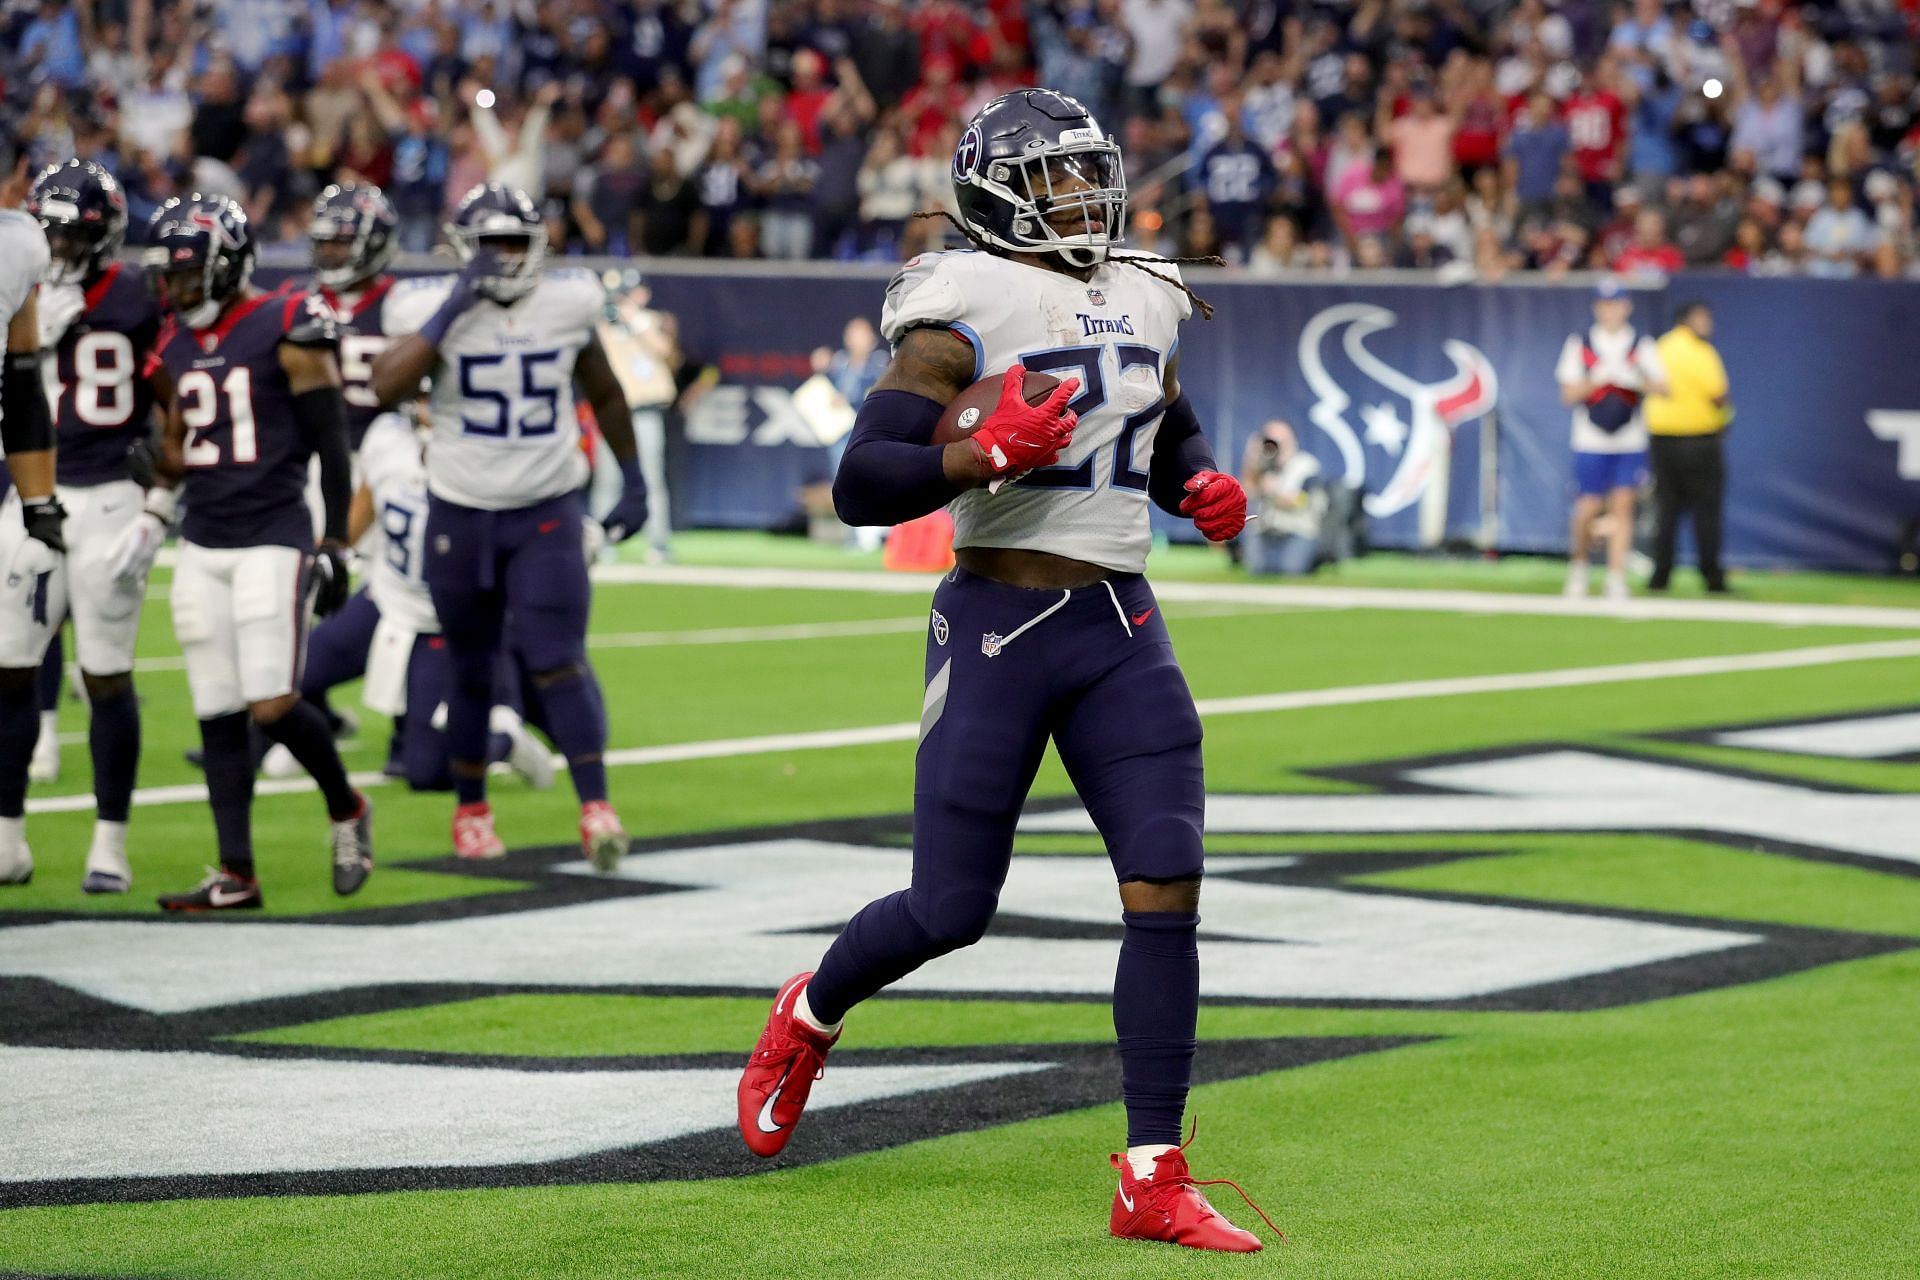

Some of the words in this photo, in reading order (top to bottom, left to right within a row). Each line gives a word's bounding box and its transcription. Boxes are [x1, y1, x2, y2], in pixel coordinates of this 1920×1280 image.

[1076, 313, 1134, 337] TITANS
[178, 366, 258, 466] 21
[459, 350, 561, 438] 55
[1018, 342, 1165, 494] 22
